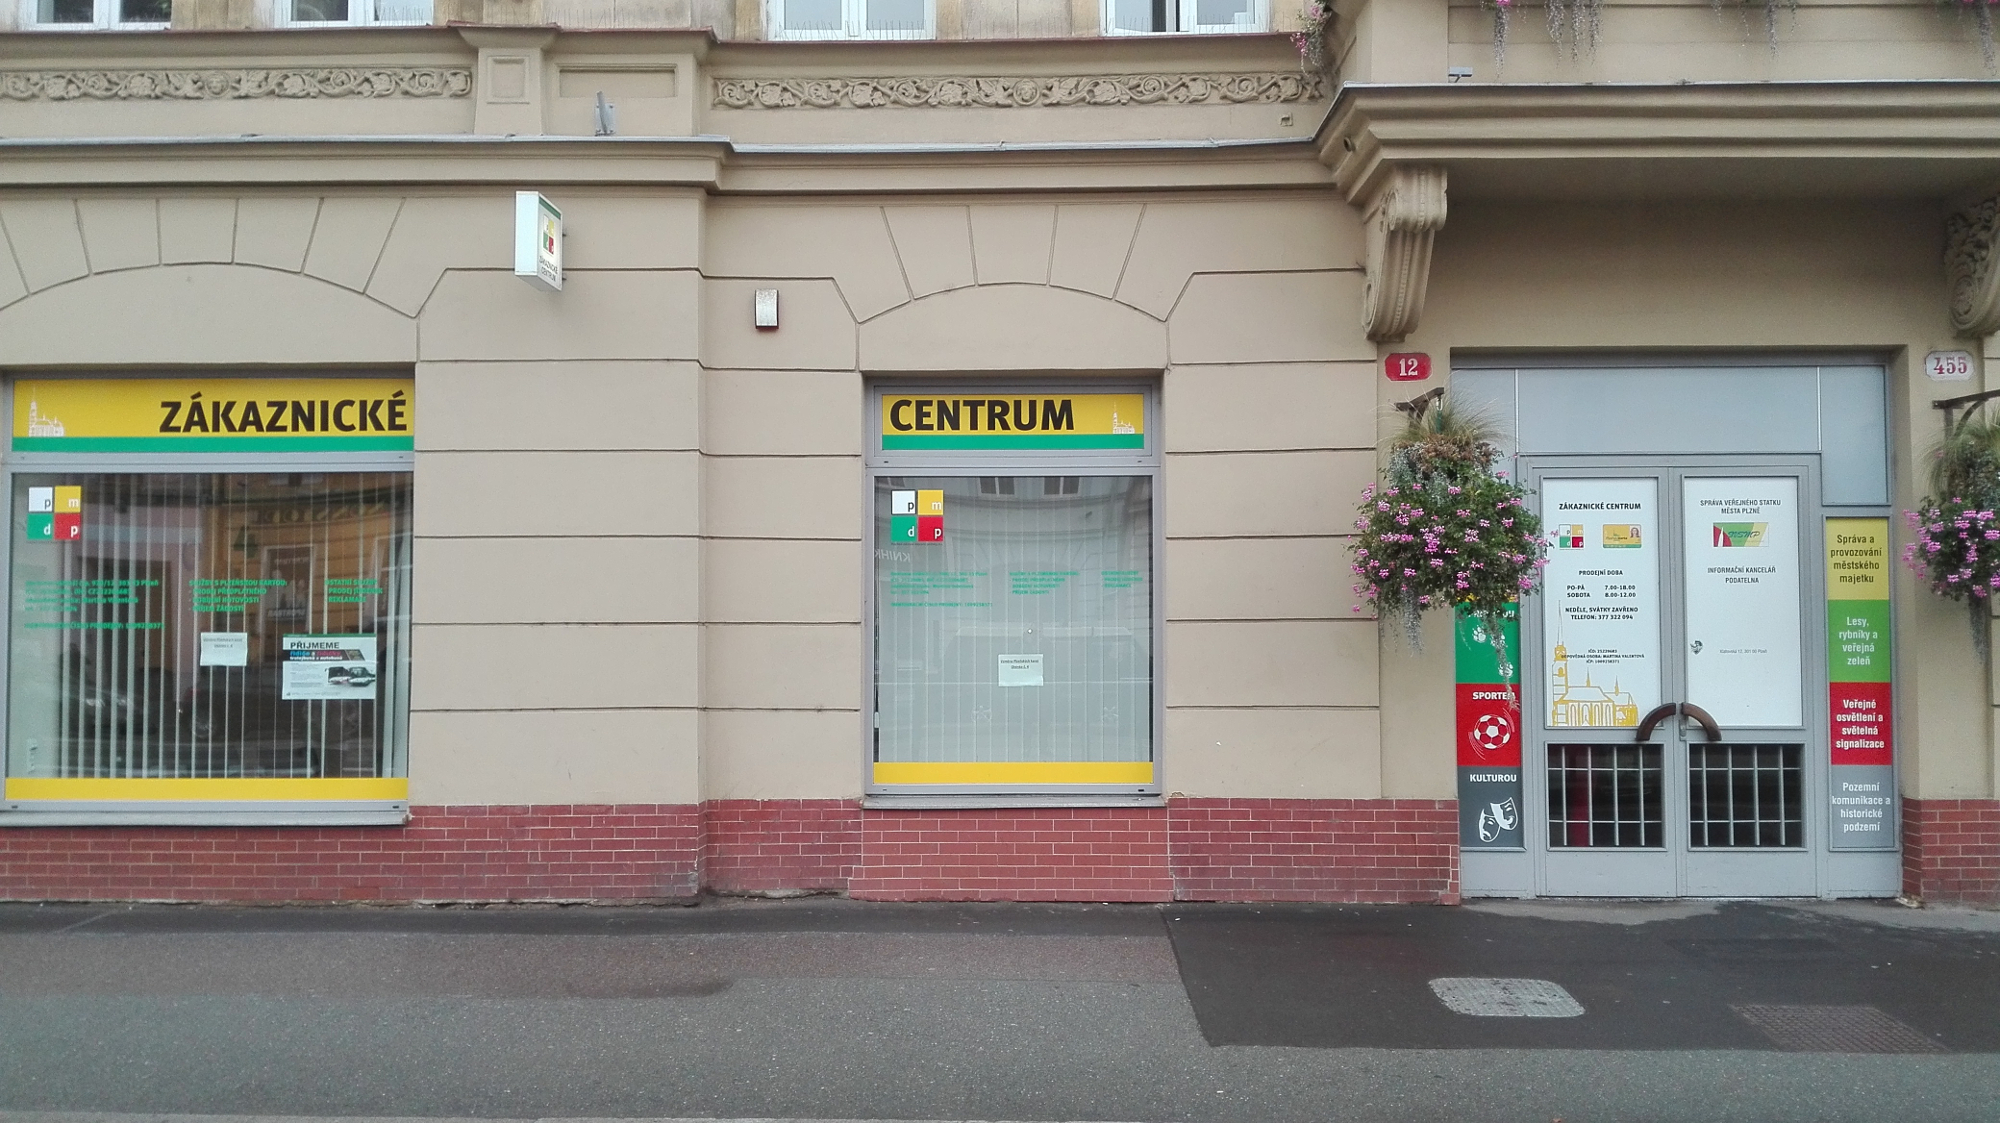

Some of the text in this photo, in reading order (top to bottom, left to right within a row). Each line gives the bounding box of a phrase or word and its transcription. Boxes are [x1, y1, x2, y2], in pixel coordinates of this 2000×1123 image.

[1399, 358, 1418, 376] 12
[1934, 356, 1967, 374] 455
[159, 390, 408, 432] ZÁKAZNICKÉ
[890, 399, 1074, 431] CENTRUM
[44, 498, 79, 509] p m
[907, 501, 942, 512] p m
[1559, 502, 1604, 510] ZÁKAZNICKÉ
[44, 523, 78, 538] d p
[907, 526, 942, 539] d p
[1837, 534, 1866, 545] Správa
[1831, 548, 1882, 558] provozování
[1833, 560, 1880, 569] městského
[1840, 574, 1874, 584] majetku
[1847, 617, 1869, 628] Lesy,
[1839, 629, 1870, 640] rybníky
[290, 641, 339, 649] PŘIJMEME
[1842, 643, 1874, 654] veřejná
[1847, 656, 1870, 665] zeleň
[1843, 699, 1876, 710] Veřejné
[1836, 712, 1876, 722] osvětlení
[1842, 726, 1878, 735] světelná
[1836, 739, 1884, 750] signalizace
[1470, 774, 1517, 782] KULTUROU
[1843, 782, 1880, 791] Pozemní
[1832, 795, 1883, 805] komunikace
[1840, 809, 1882, 818] historické
[1844, 822, 1880, 833] podzemí
